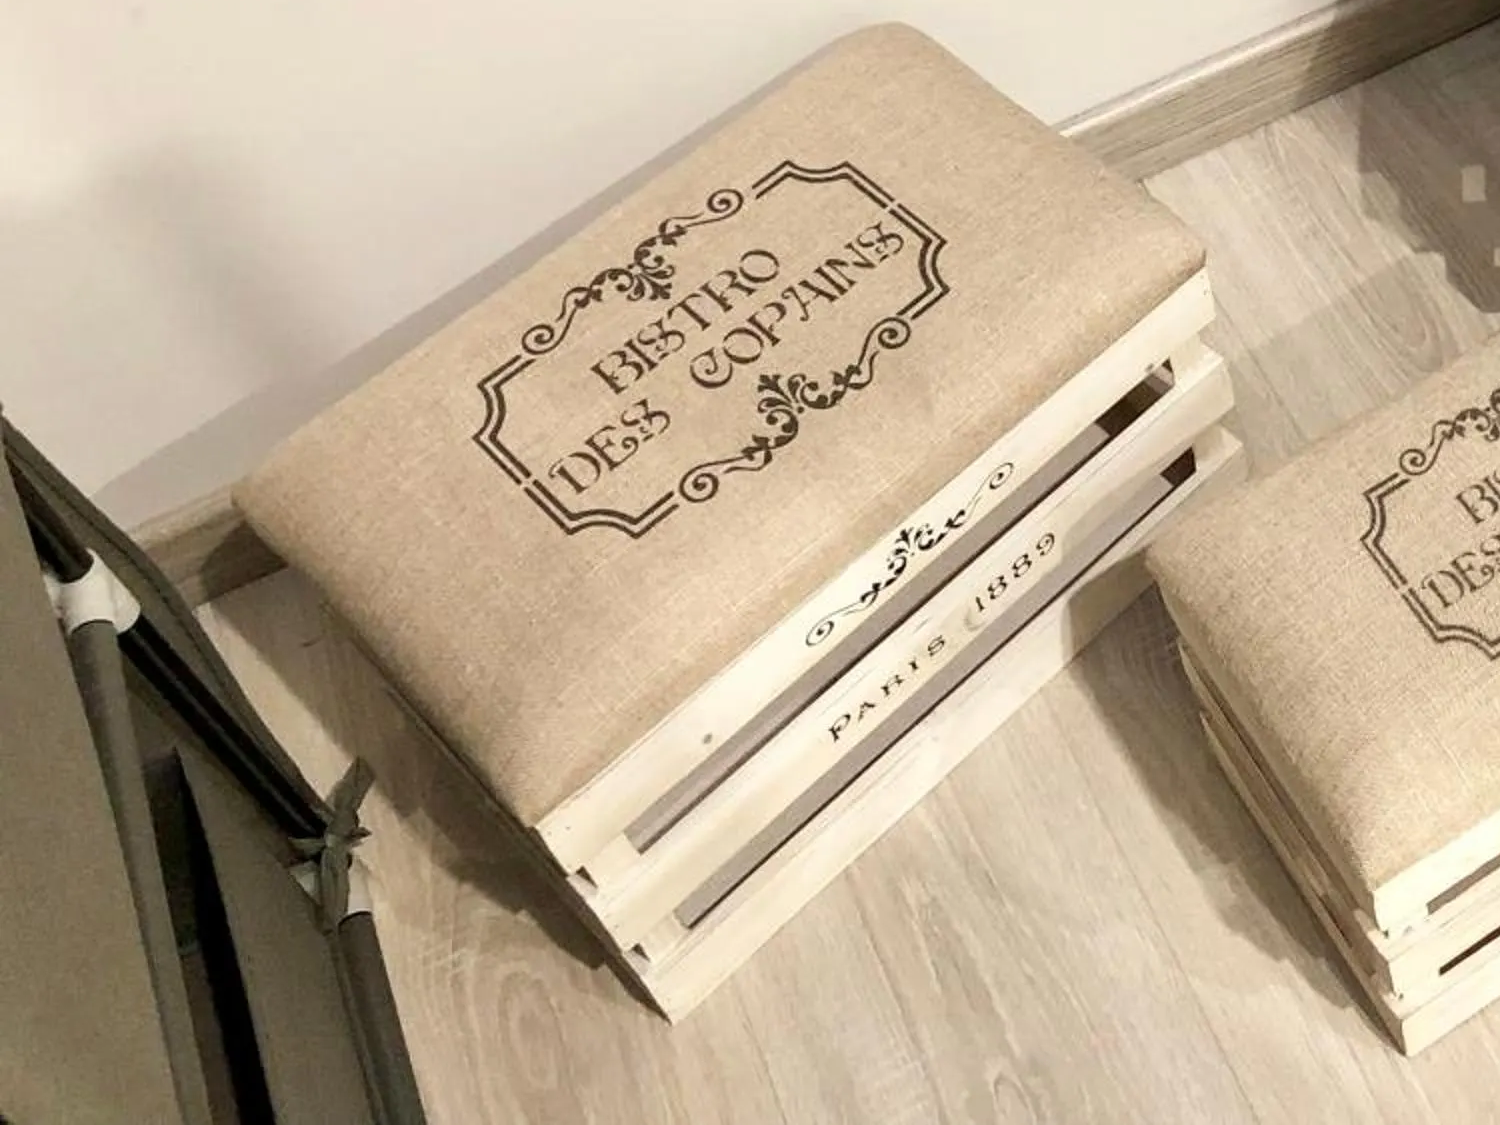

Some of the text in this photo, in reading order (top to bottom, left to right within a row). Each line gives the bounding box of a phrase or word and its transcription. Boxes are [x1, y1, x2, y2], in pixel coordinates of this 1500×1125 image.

[549, 221, 905, 495] DES COPAINS
[591, 247, 781, 396] BISTRO
[972, 532, 1056, 614] 1889
